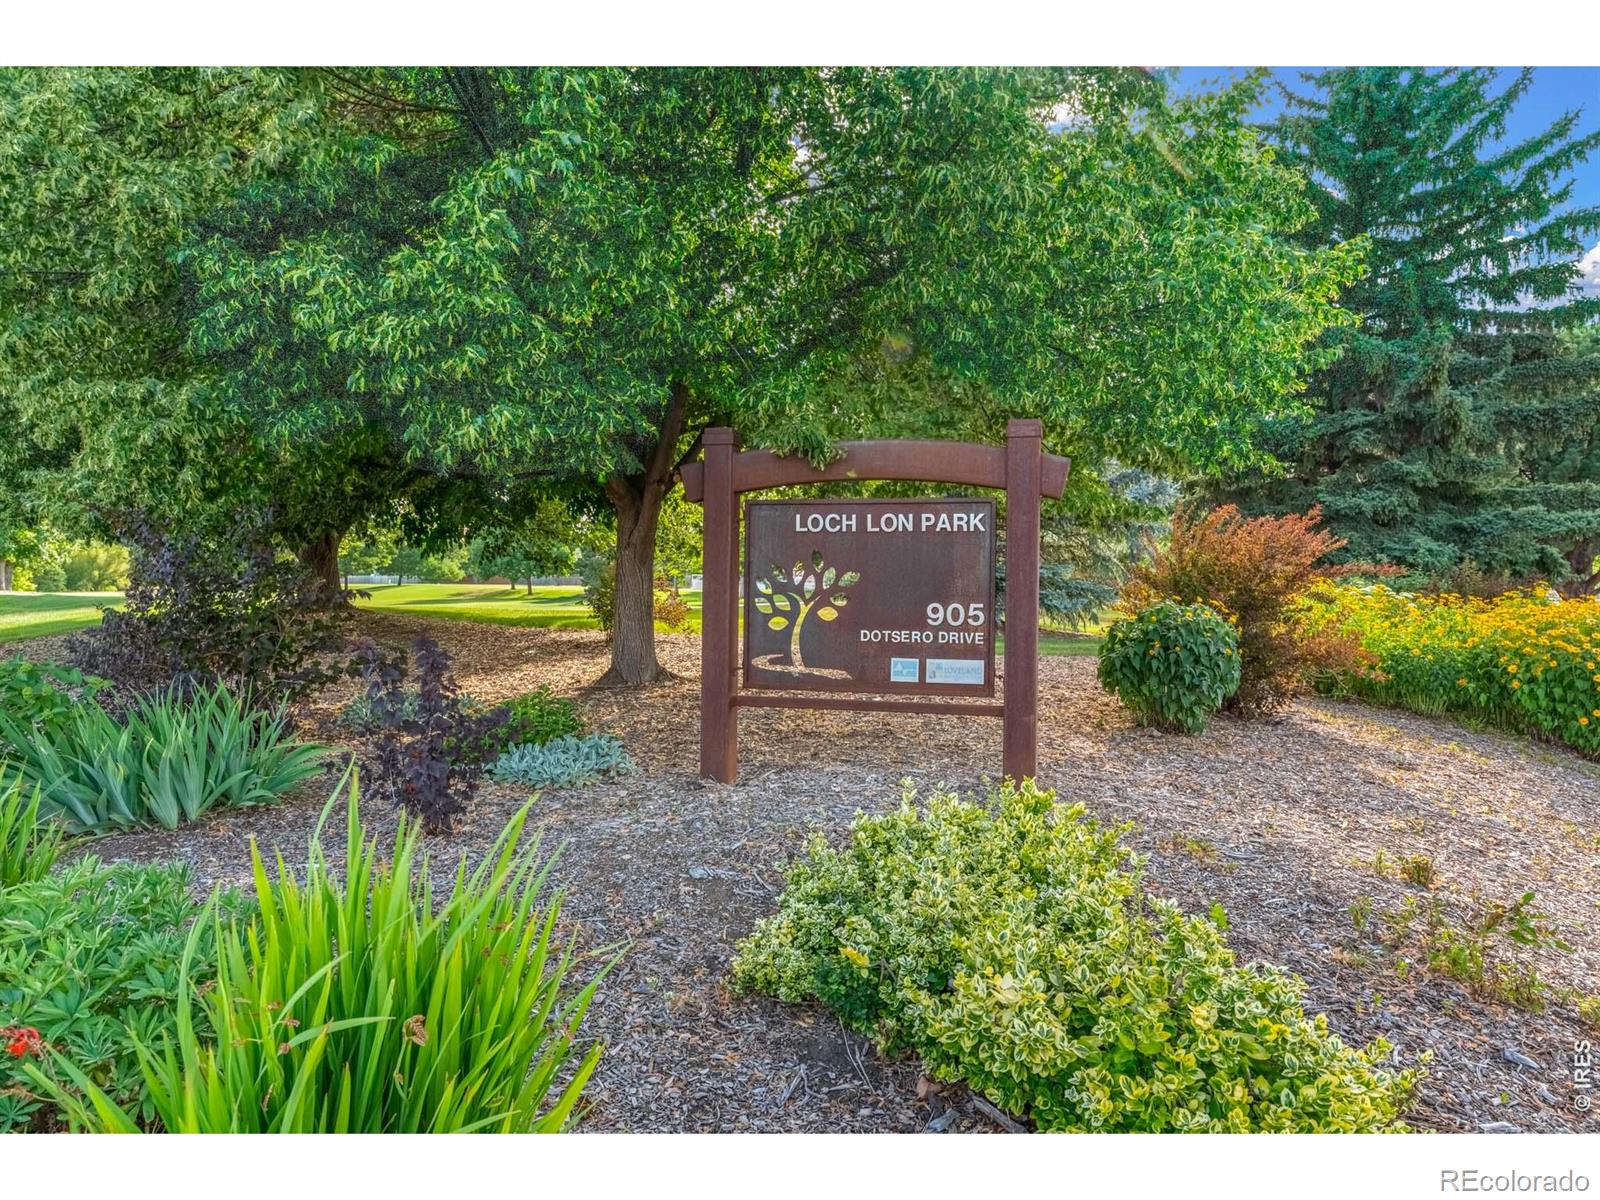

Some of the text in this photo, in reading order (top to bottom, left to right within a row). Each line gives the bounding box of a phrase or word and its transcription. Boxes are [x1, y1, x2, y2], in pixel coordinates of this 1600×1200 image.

[795, 513, 986, 532] LOCH LON PARK
[926, 602, 985, 626] 905
[860, 630, 985, 645] DOTSERO DRIVE
